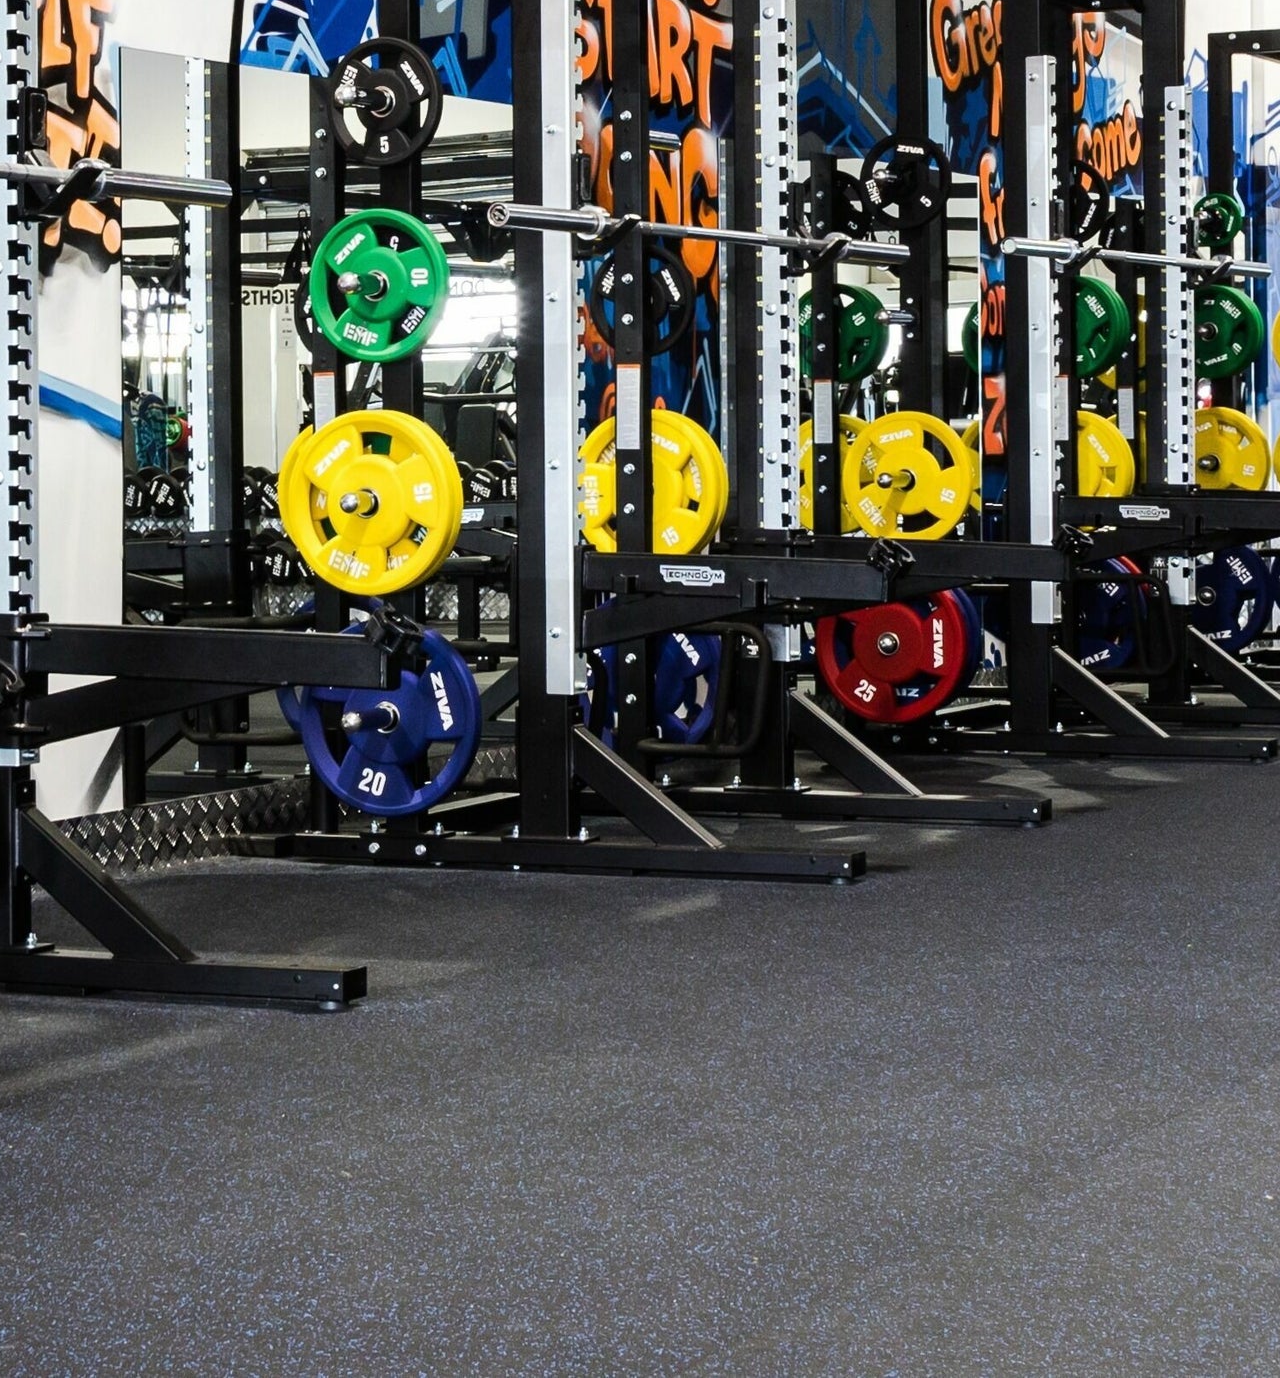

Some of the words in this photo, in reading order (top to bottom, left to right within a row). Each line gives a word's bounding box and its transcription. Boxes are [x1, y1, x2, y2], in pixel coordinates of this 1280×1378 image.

[399, 60, 425, 96] ZIVA
[379, 135, 390, 154] 5
[896, 144, 925, 155] ZIVA
[919, 195, 932, 208] 5
[333, 232, 366, 266] ZIVA
[410, 267, 429, 288] 10
[343, 322, 379, 347] EMF
[878, 428, 914, 444] ZIVA
[313, 439, 352, 478] ZIVA
[412, 481, 433, 504] 15
[939, 487, 957, 503] 15
[858, 496, 887, 528] EMF
[660, 525, 680, 547] 15
[327, 549, 370, 579] EMF
[662, 566, 723, 582] TECHNOGYM
[1225, 554, 1254, 585] EMF
[932, 617, 944, 669] ZIVA
[429, 671, 454, 732] ZIVA
[853, 678, 877, 703] 25
[357, 767, 387, 797] 20
